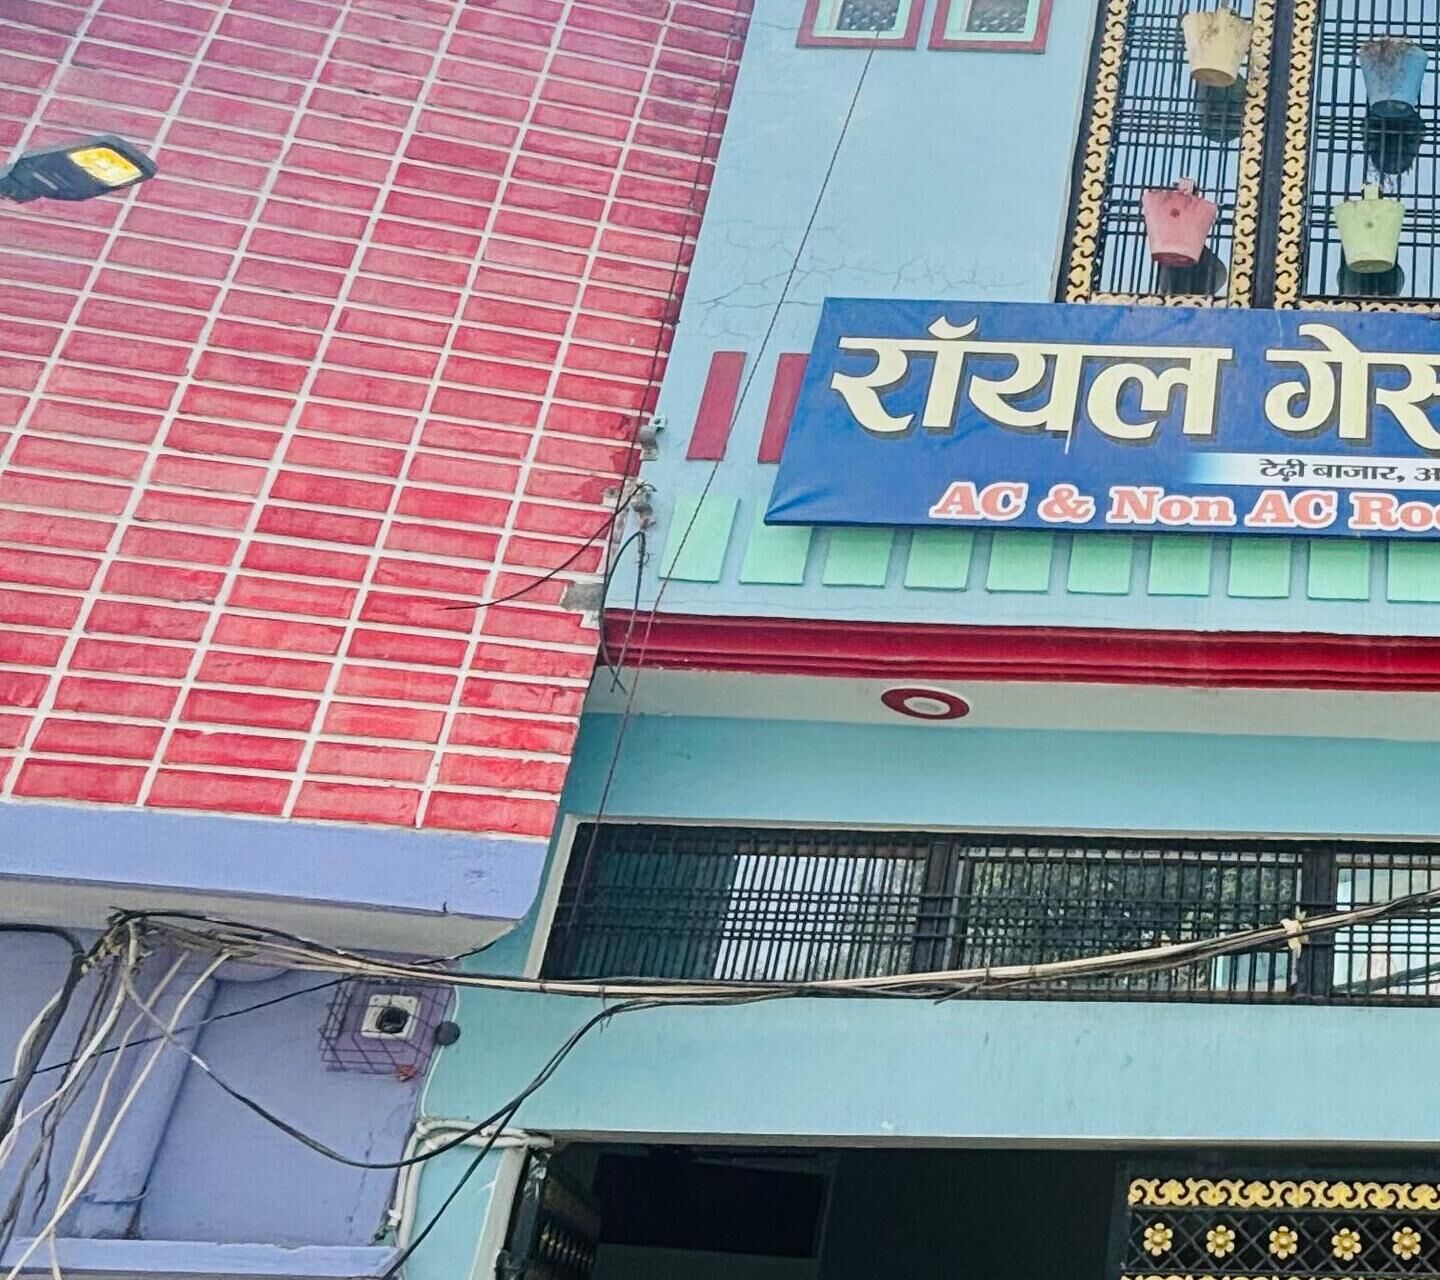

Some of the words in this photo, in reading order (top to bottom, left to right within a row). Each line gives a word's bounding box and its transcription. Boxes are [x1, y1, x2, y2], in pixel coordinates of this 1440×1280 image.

[831, 315, 1233, 440] रॉयल
[931, 481, 1028, 519] AC
[1039, 483, 1095, 522] &
[1106, 487, 1236, 526] Non
[1245, 487, 1338, 528] AC
